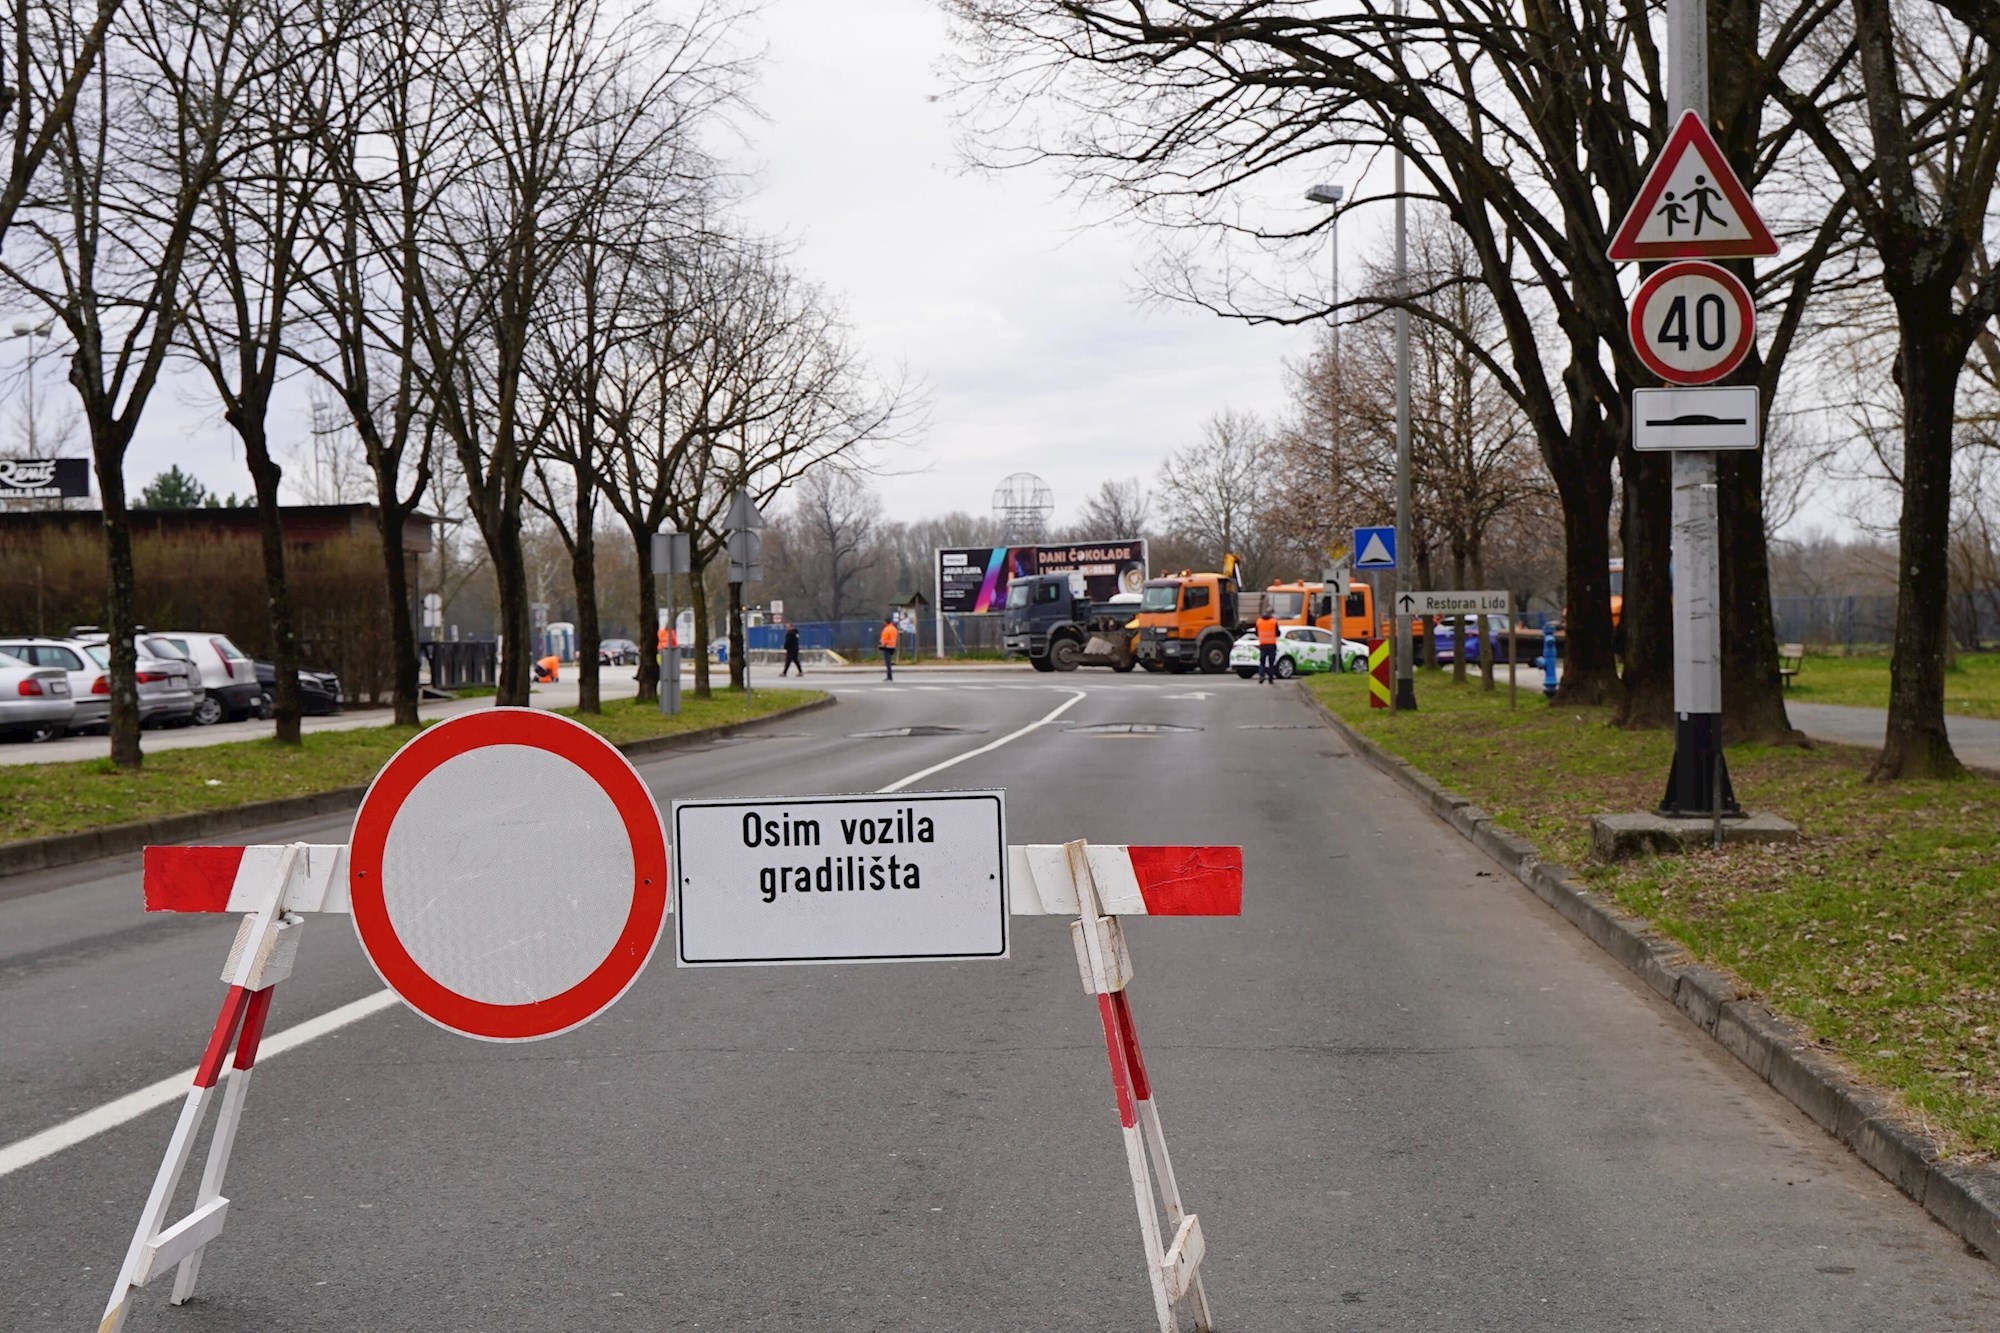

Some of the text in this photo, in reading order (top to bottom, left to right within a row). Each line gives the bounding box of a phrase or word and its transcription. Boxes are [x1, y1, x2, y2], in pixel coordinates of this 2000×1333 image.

[1657, 293, 1726, 351] 40
[34, 487, 61, 497] BAR
[1039, 547, 1131, 563] DANI ČOKOLADE
[1426, 597, 1506, 609] Restoran Lido
[742, 808, 935, 848] Osim vozila
[760, 855, 920, 903] gradilišta
